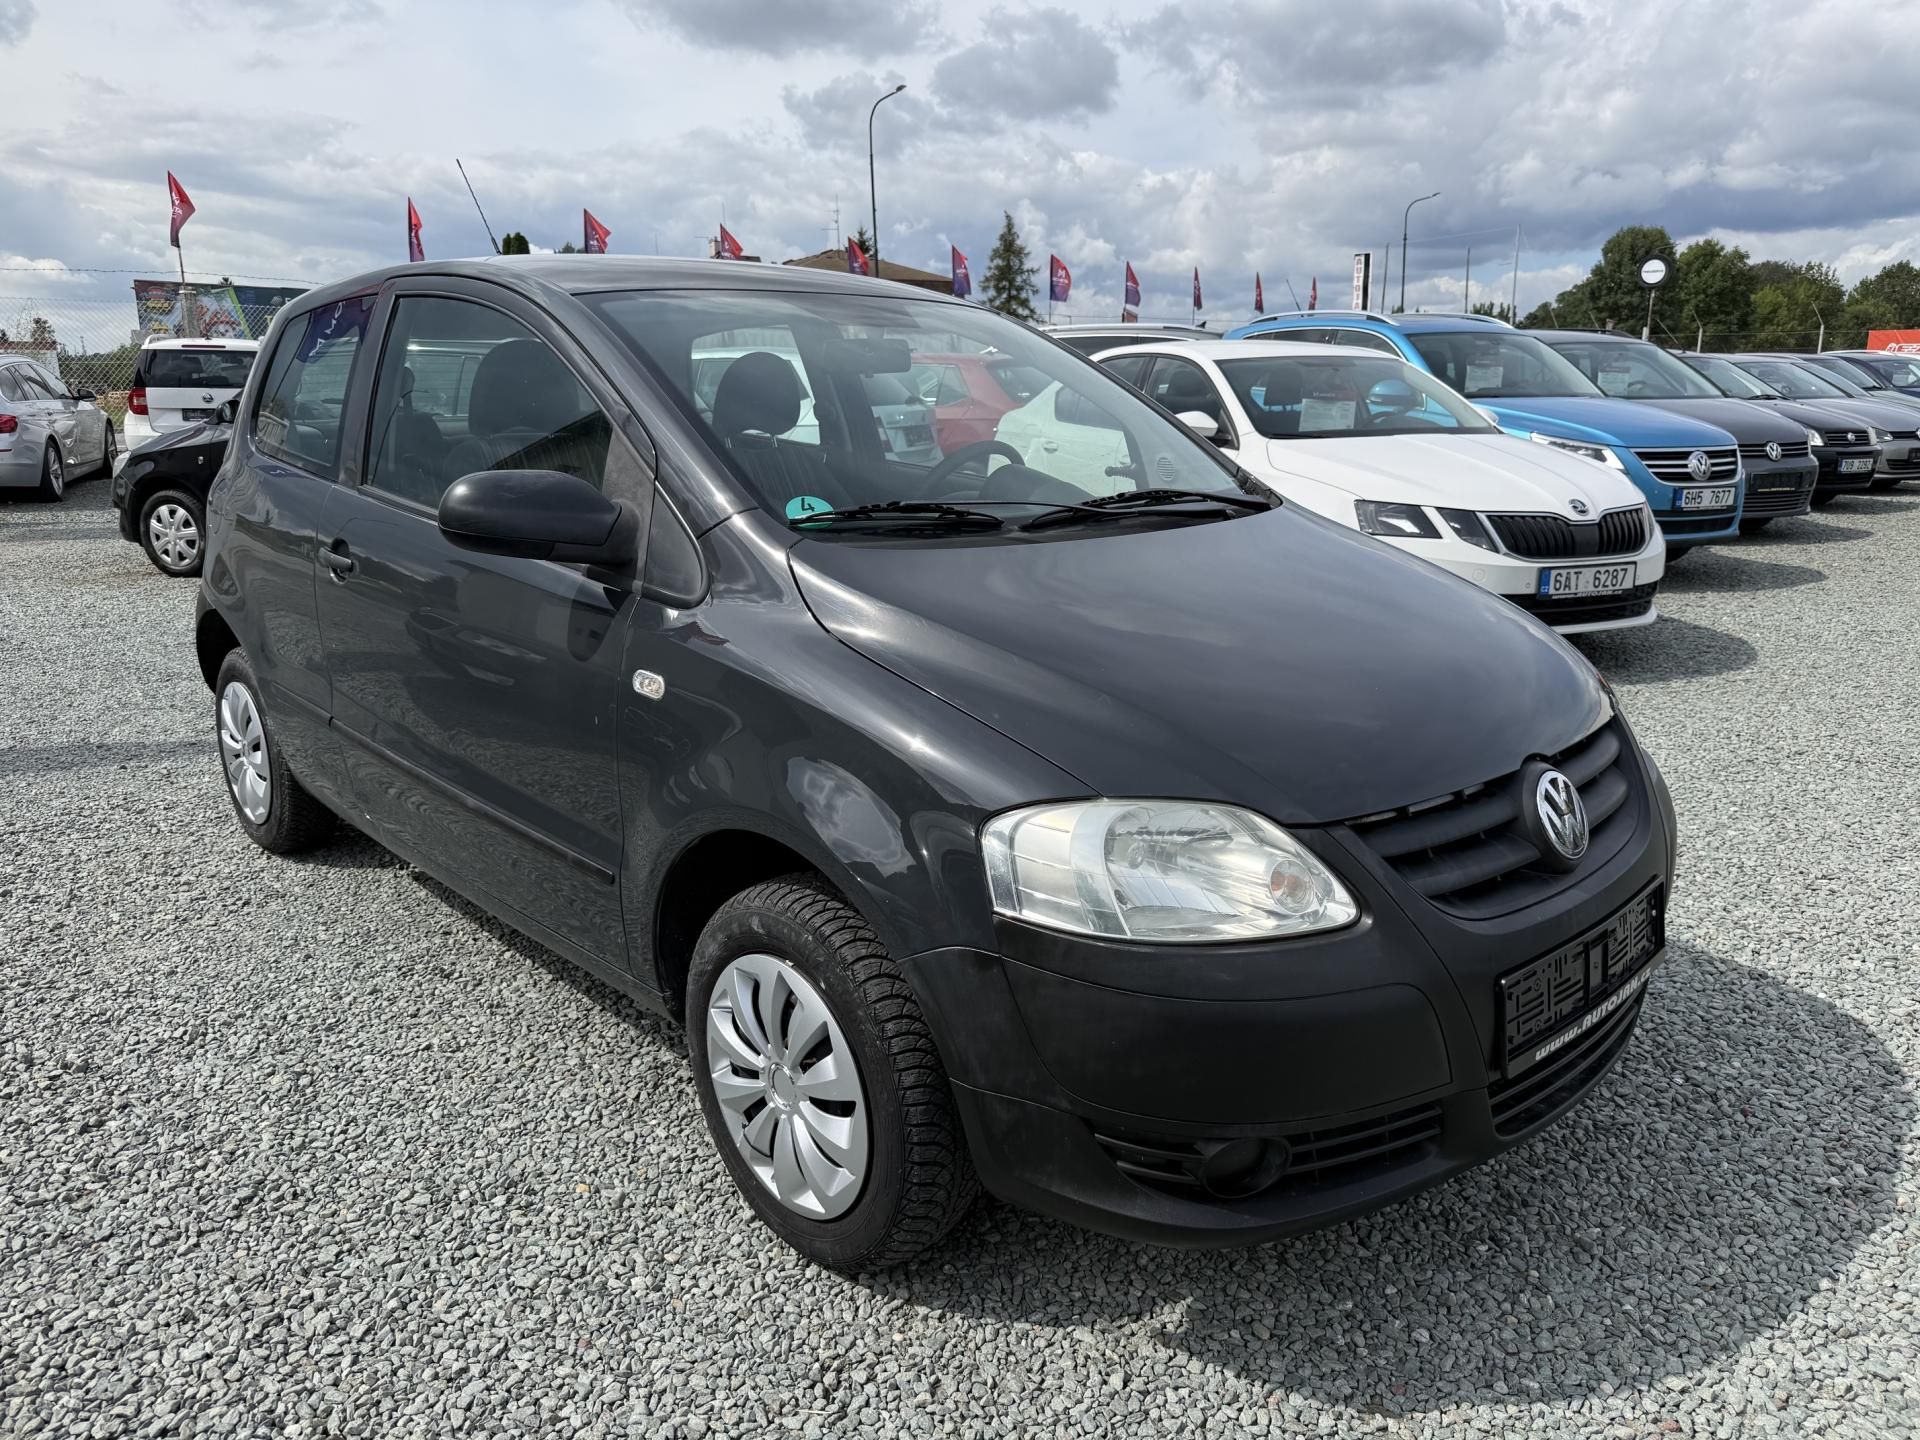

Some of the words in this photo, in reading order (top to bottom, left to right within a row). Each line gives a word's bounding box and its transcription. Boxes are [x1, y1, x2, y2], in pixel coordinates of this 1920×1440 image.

[800, 497, 815, 512] 4
[1684, 490, 1704, 505] 6H5
[1709, 490, 1731, 504] 7677
[1553, 571, 1582, 592] 6AT
[1592, 567, 1628, 589] 6287
